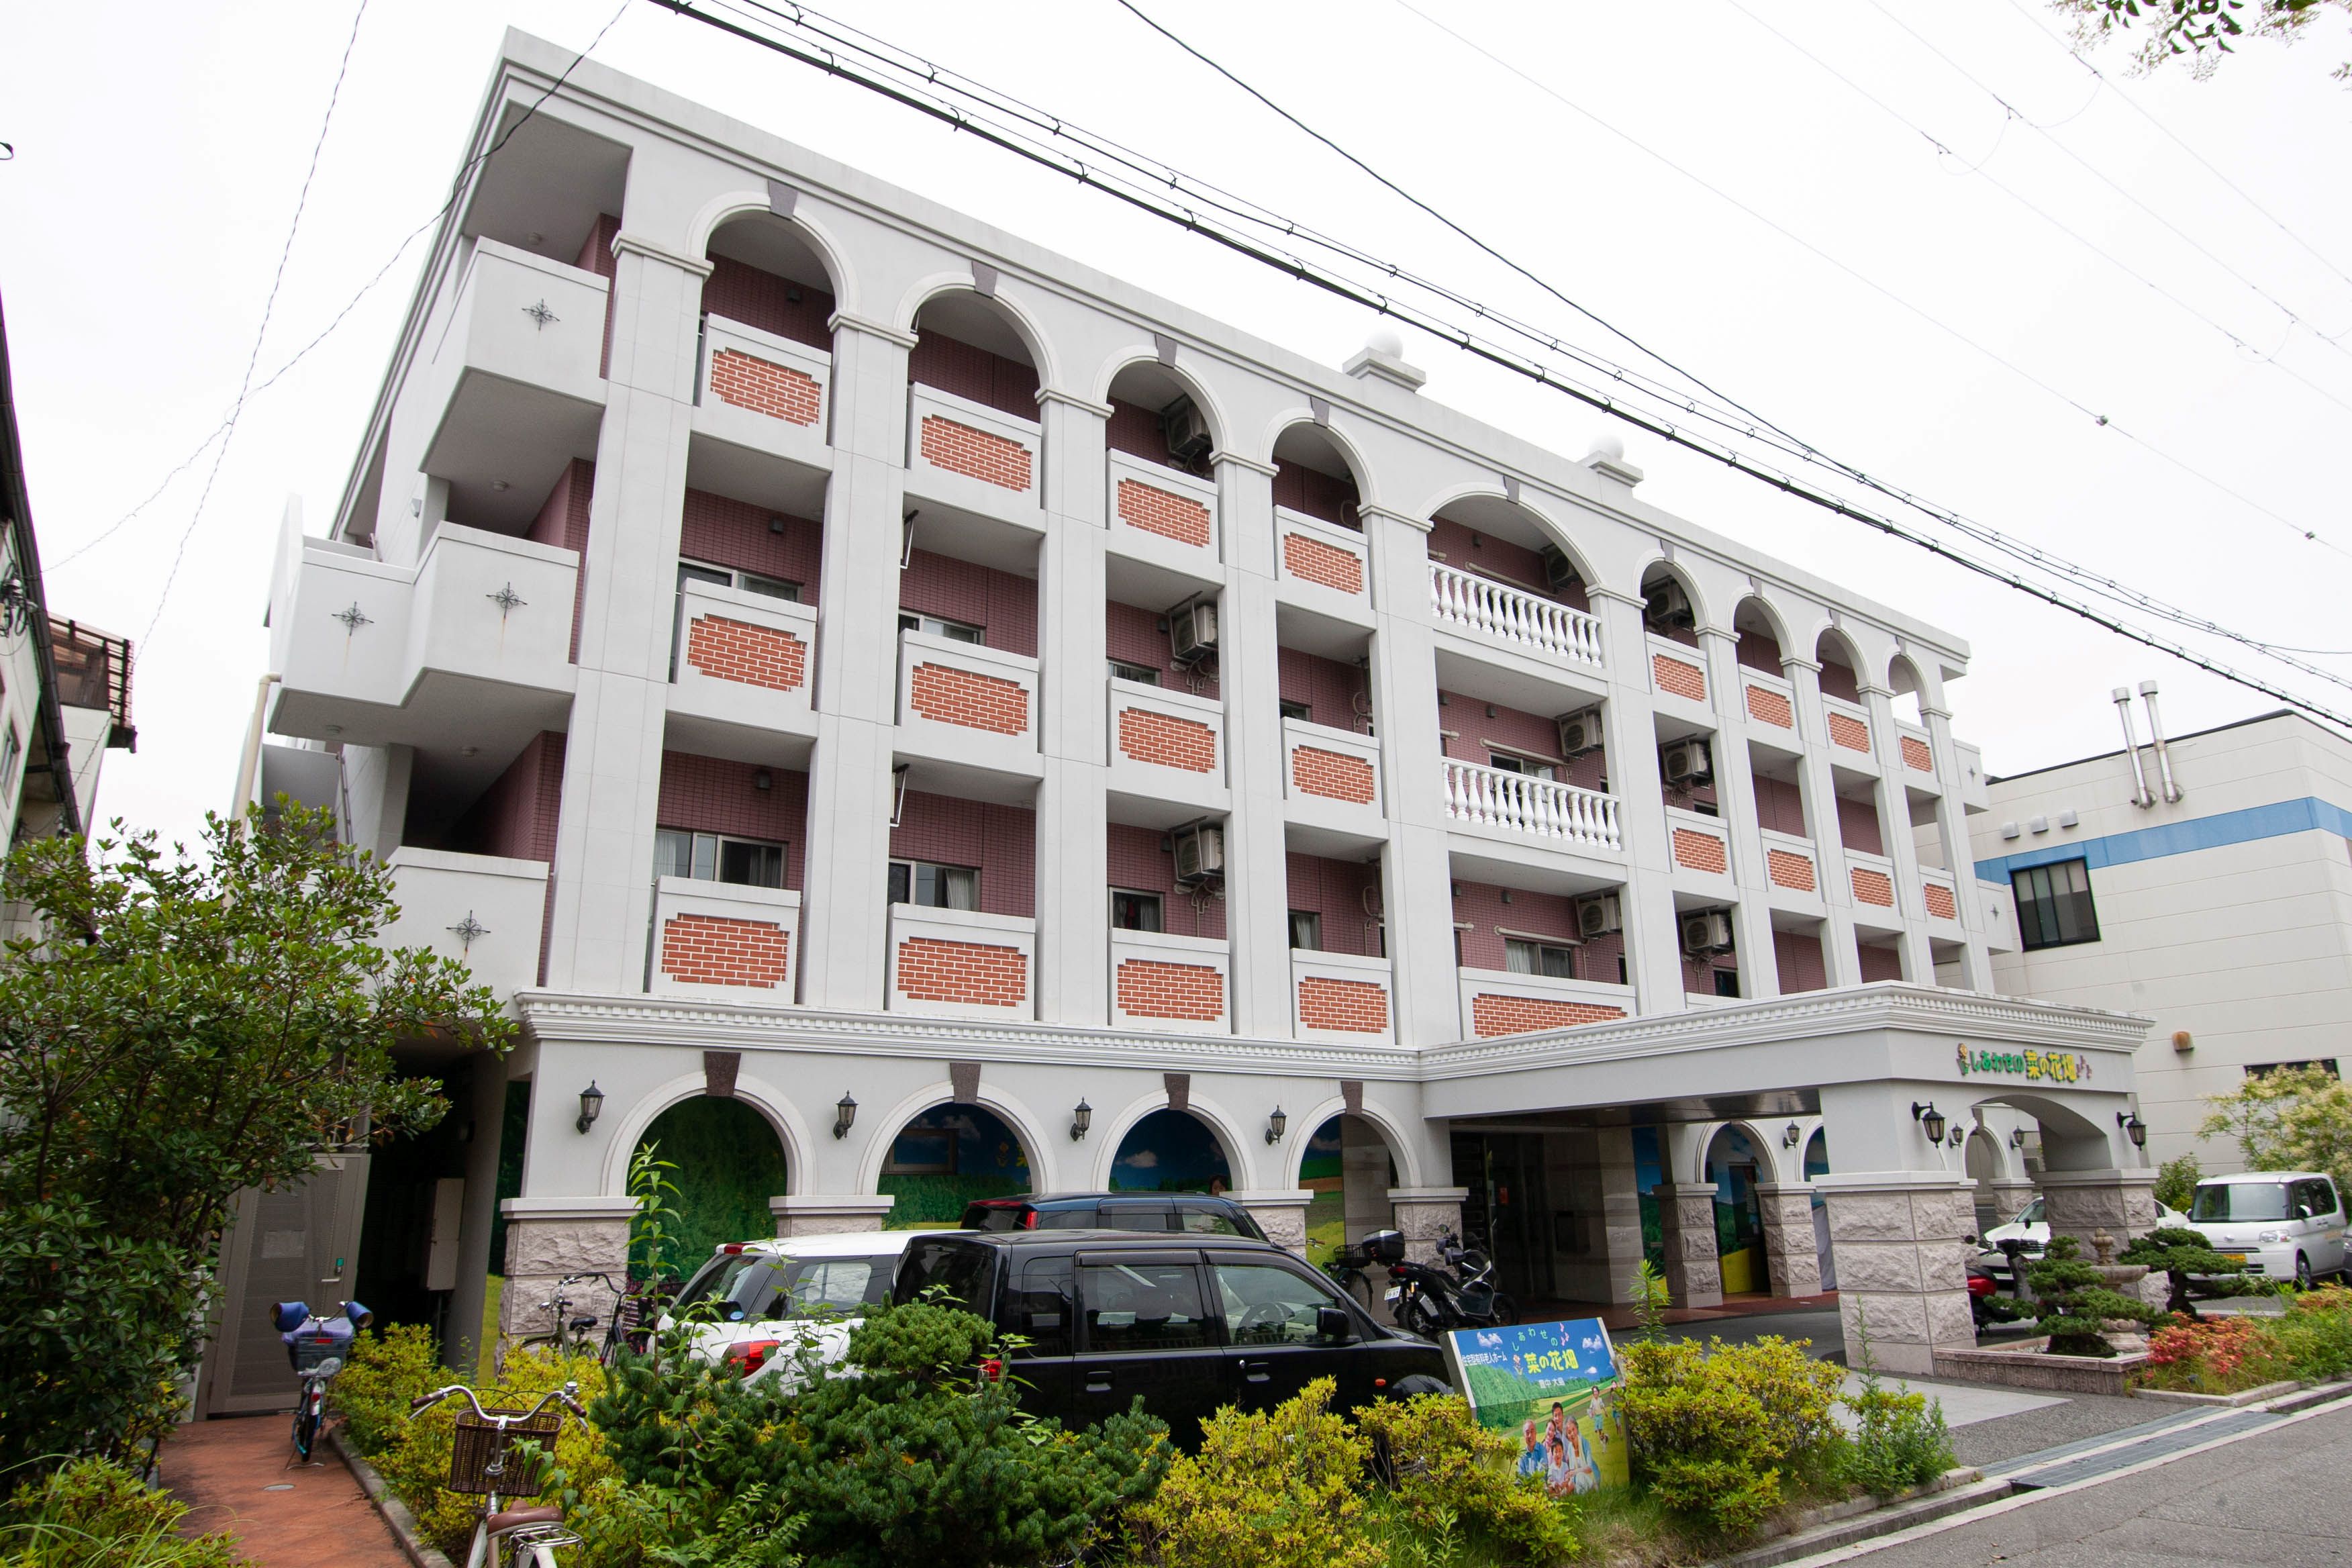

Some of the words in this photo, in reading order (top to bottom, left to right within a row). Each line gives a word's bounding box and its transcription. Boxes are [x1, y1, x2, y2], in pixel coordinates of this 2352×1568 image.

[1512, 1326, 1558, 1351] しあわせの
[1524, 1349, 1579, 1374] 菜の花畑
